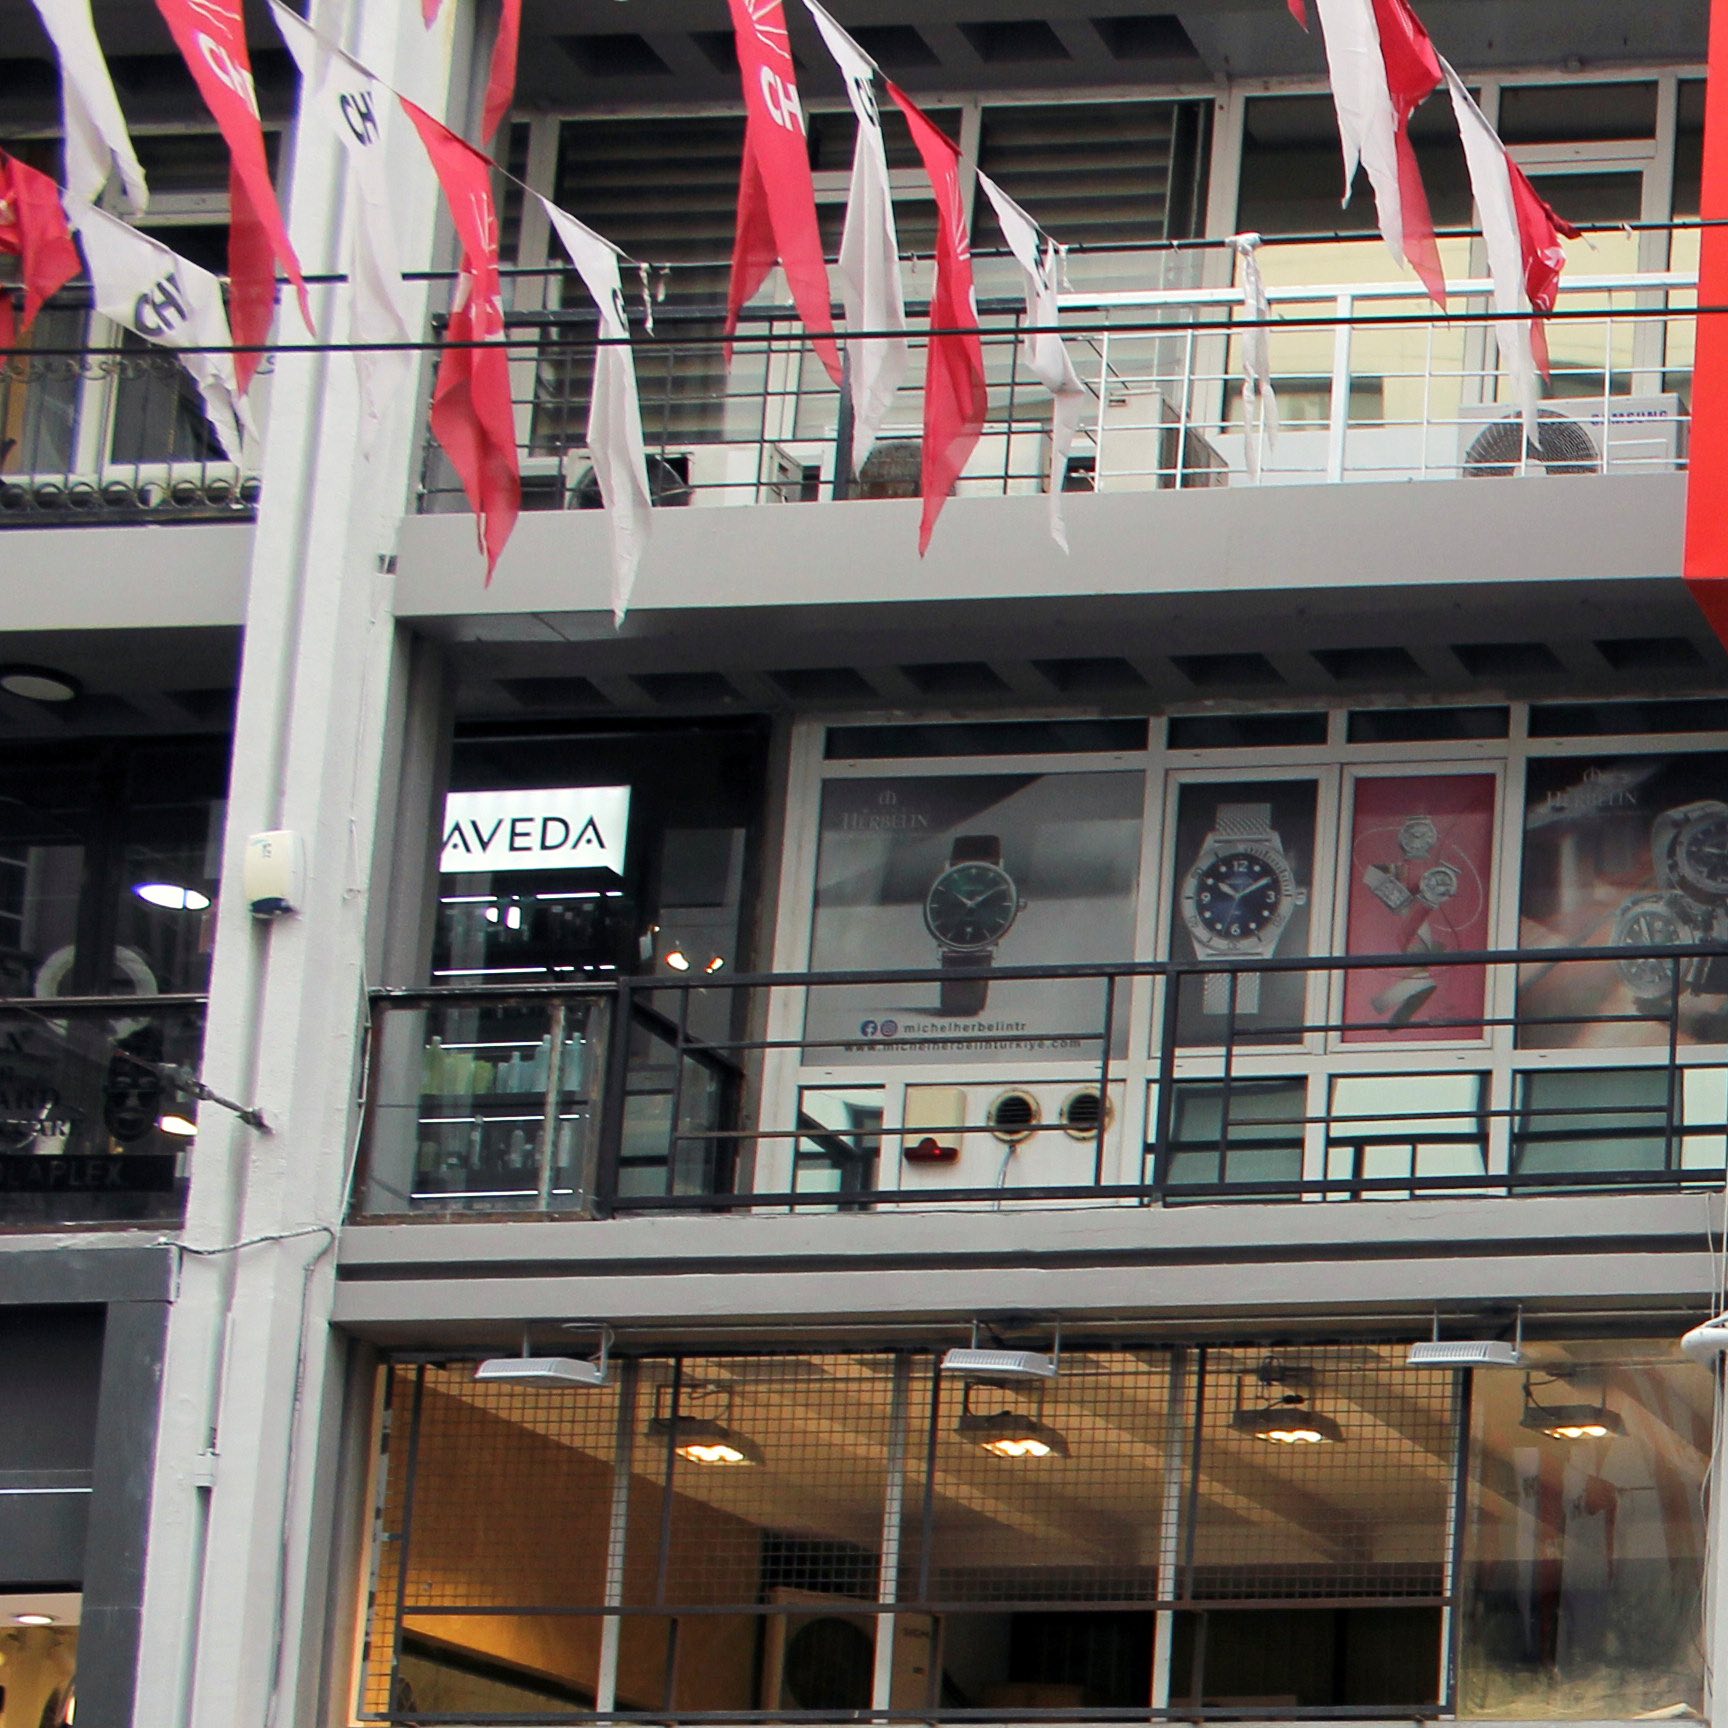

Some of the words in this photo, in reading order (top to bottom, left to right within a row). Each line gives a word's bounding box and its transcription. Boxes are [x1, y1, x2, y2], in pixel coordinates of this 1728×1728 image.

[340, 88, 381, 147] CH
[761, 64, 806, 137] CH
[134, 272, 189, 337] CH
[1591, 409, 1668, 426] SMSUNG
[441, 814, 608, 854] AVEDA
